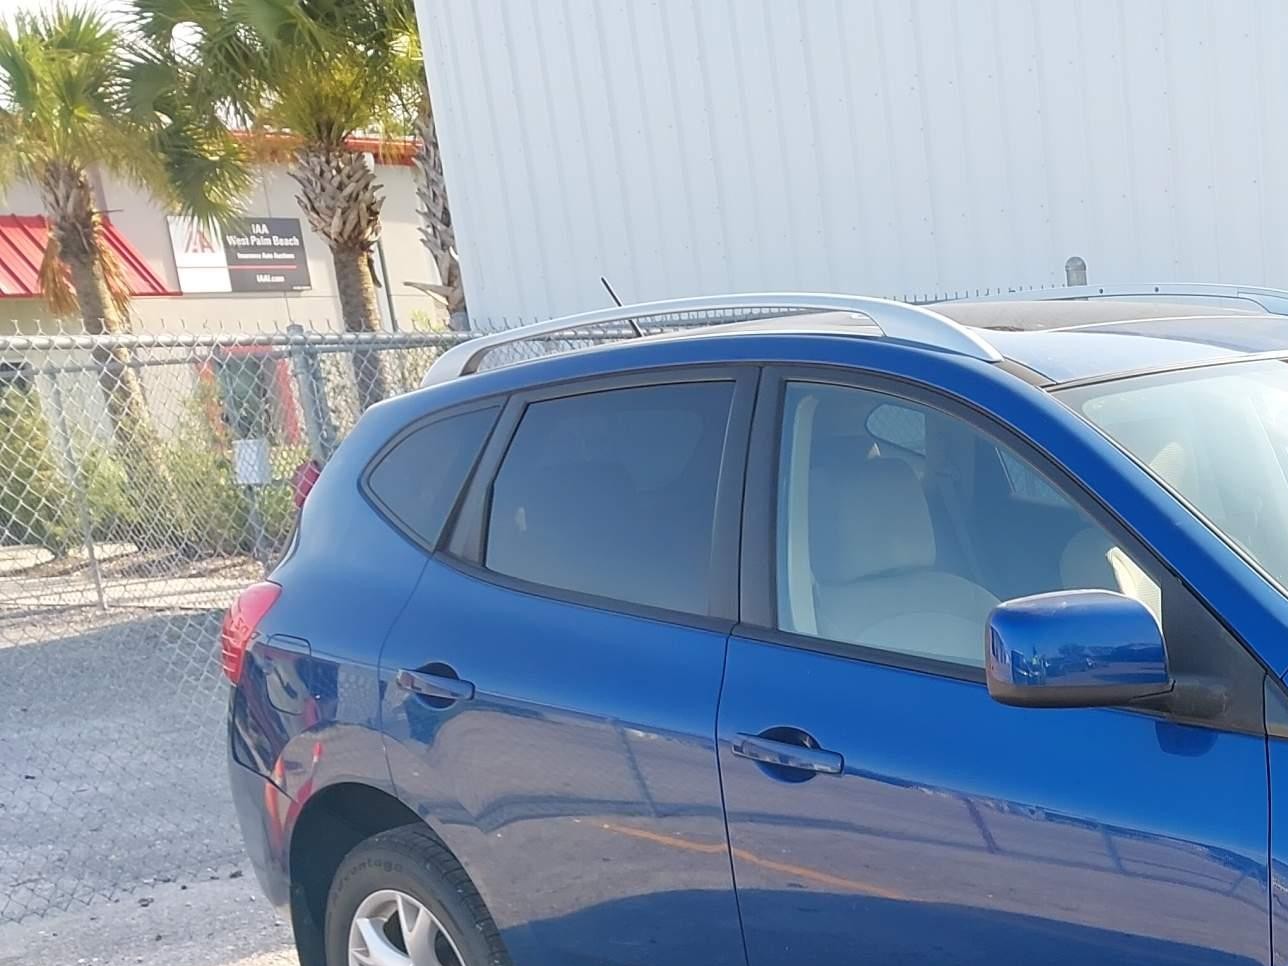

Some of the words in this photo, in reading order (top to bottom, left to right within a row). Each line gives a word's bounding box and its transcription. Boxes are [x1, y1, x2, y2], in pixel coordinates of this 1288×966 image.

[251, 223, 269, 234] IAA
[226, 235, 249, 246] West
[250, 235, 271, 246] Palm
[272, 235, 300, 247] Beach
